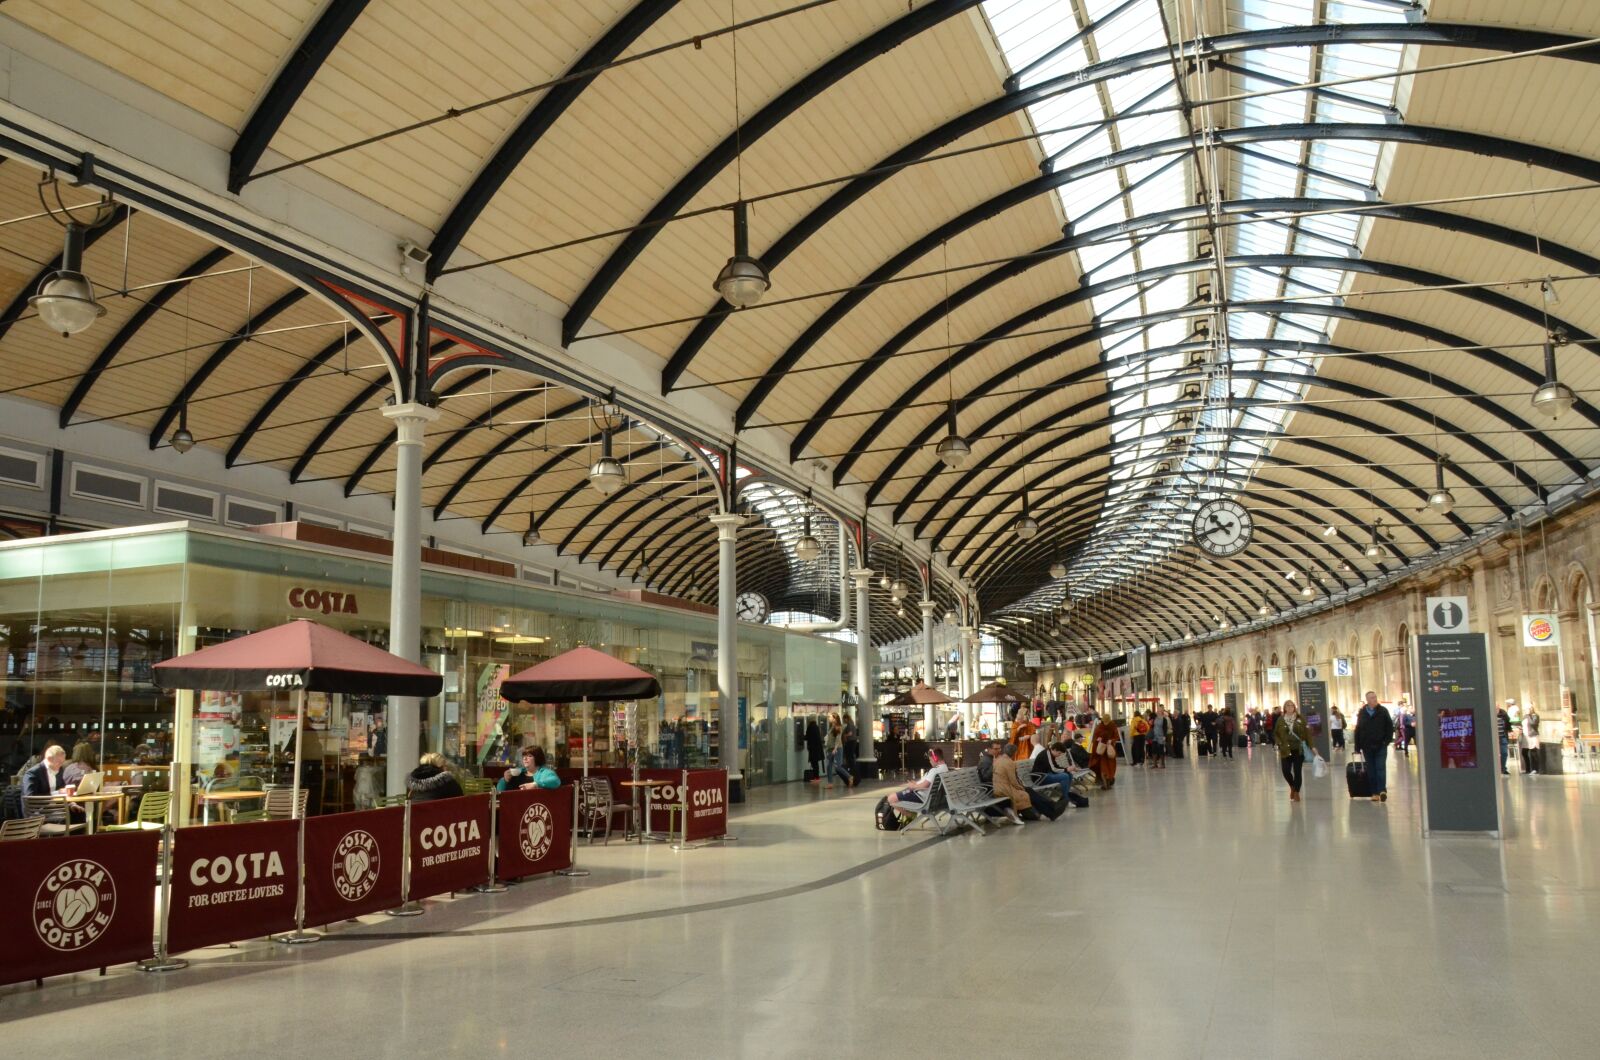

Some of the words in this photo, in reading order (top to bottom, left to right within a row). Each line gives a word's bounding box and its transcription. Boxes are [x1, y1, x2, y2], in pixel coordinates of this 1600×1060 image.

[289, 587, 358, 614] COSTA
[1532, 627, 1551, 637] KING
[266, 674, 303, 687] COSTA
[487, 686, 500, 698] GET
[481, 700, 506, 712] NOTED
[1440, 721, 1464, 730] NEED
[1441, 728, 1473, 739] HAND?
[693, 788, 723, 806] COSTA
[524, 805, 548, 824] COSTA
[339, 832, 373, 856] COSTA
[420, 819, 480, 850] COSTA
[422, 855, 435, 868] FOR
[435, 850, 458, 864] COFFEE
[458, 846, 481, 859] LOVERS
[522, 836, 550, 859] COFFEE
[47, 862, 105, 892] COSTA
[190, 850, 285, 886] COSTA
[336, 870, 377, 898] COFFEE
[37, 900, 52, 910] SINCE
[188, 894, 209, 908] FOR
[211, 888, 247, 905] COFFEE
[248, 884, 284, 900] LOVERS
[39, 911, 109, 947] COFFEE
